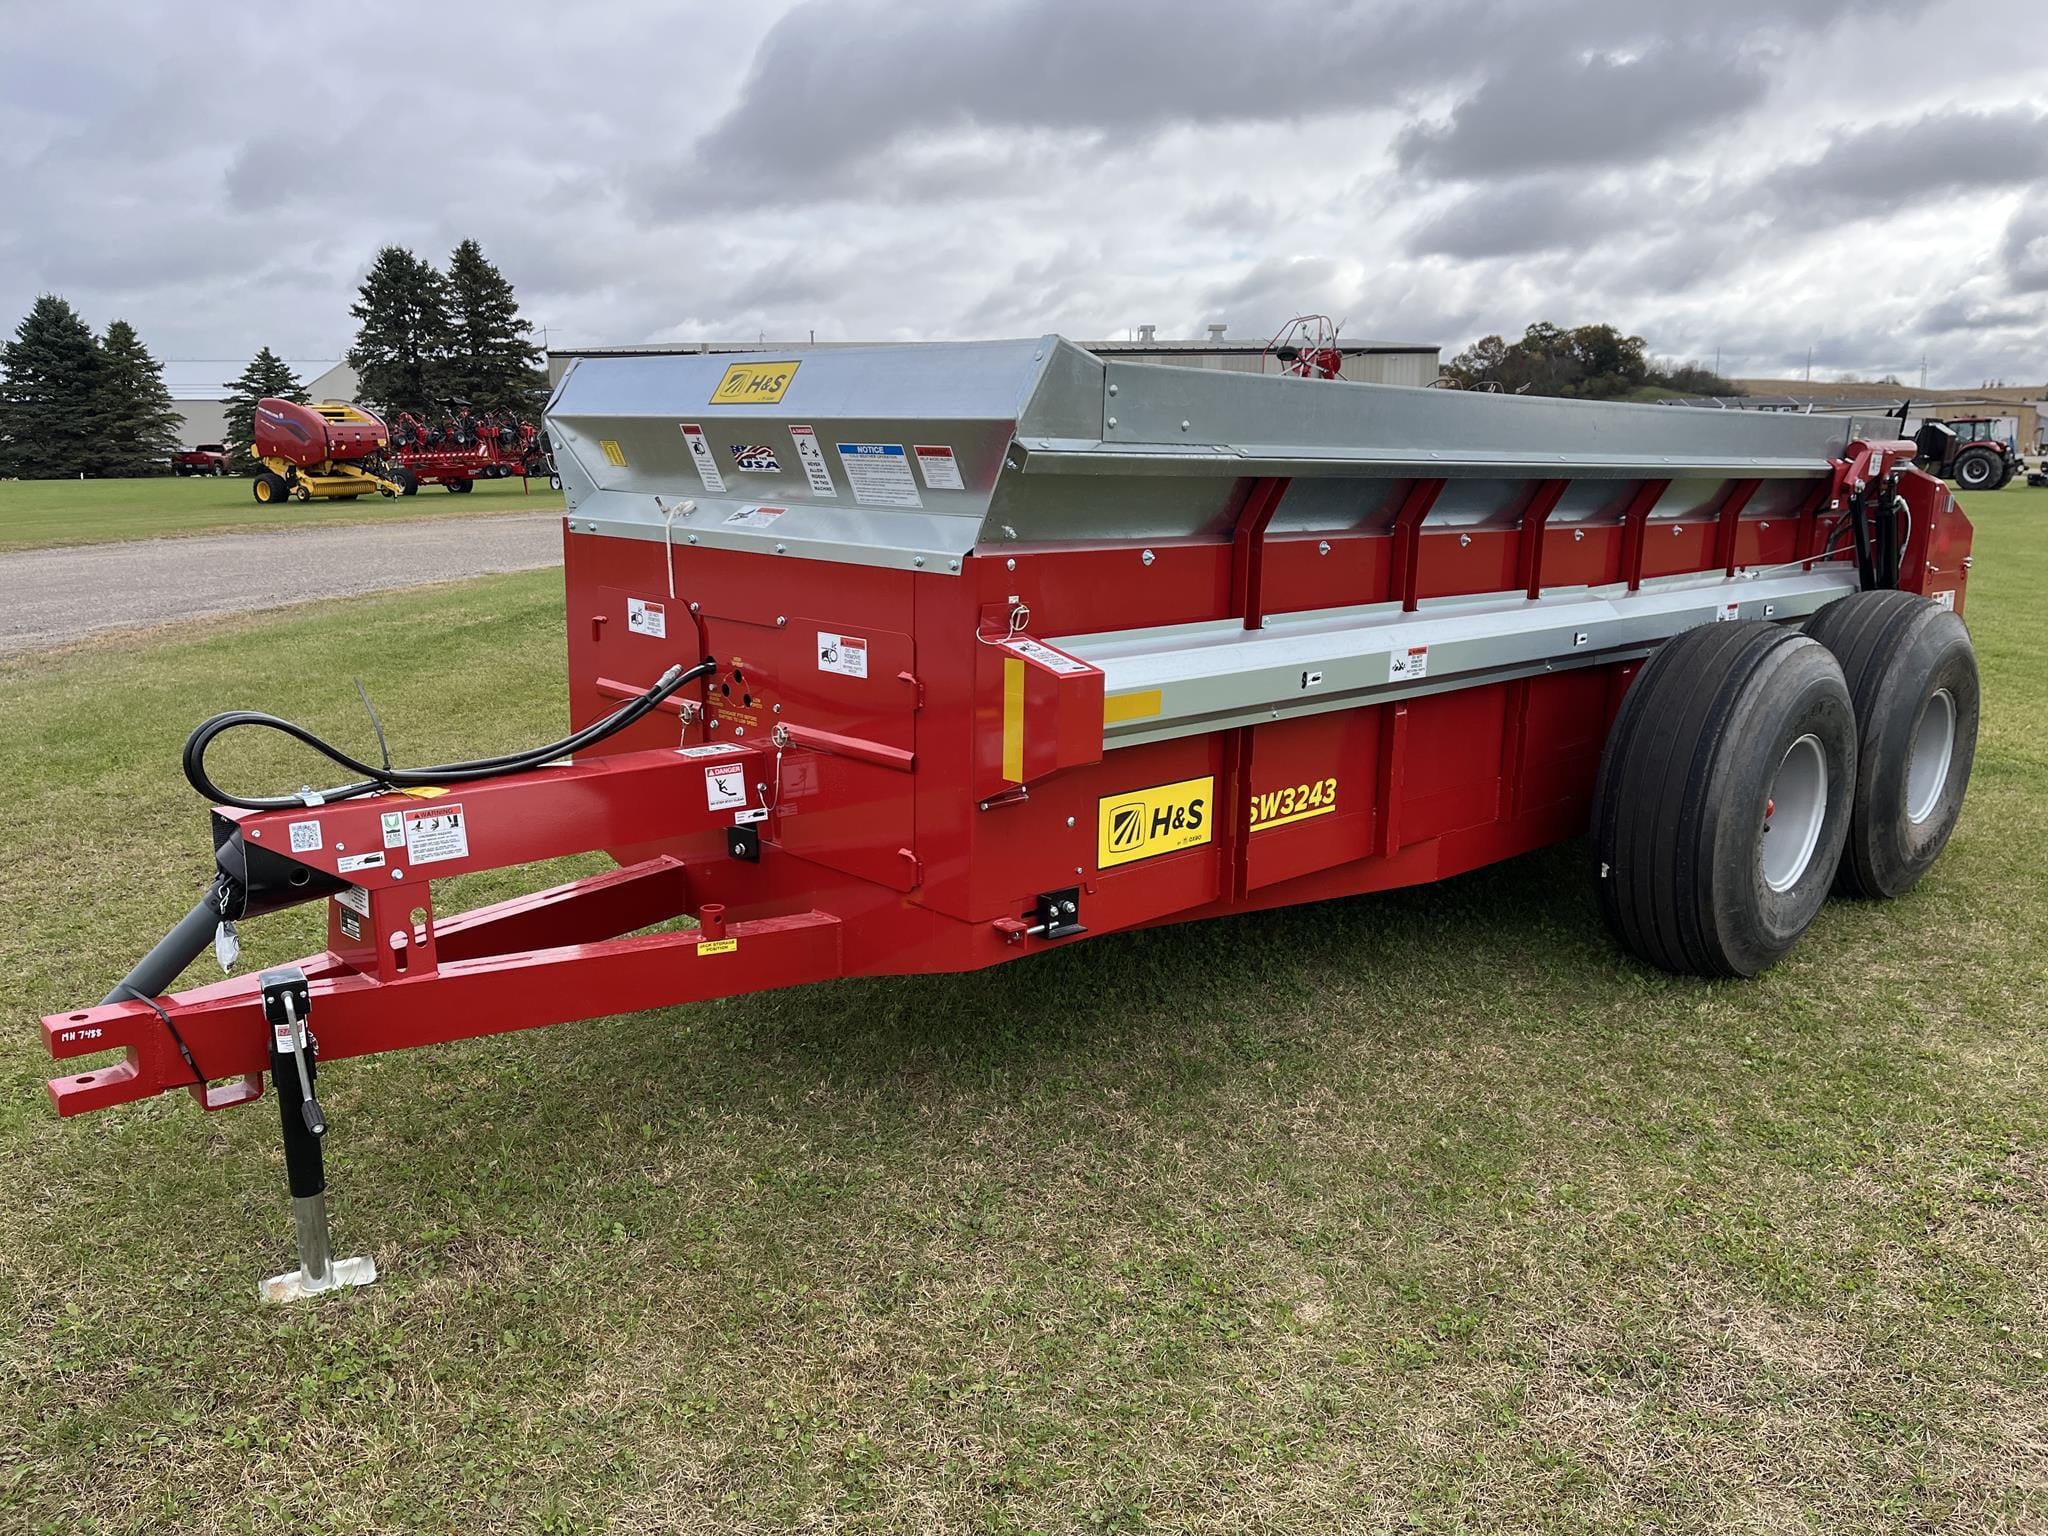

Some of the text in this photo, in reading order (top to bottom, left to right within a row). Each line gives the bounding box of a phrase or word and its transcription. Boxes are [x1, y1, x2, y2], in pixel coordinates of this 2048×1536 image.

[744, 374, 787, 393] H&S
[857, 446, 885, 454] NOTICE
[740, 460, 780, 469] USA
[714, 765, 740, 775] DANGER
[420, 808, 453, 818] WARNING
[1149, 799, 1204, 839] H&S
